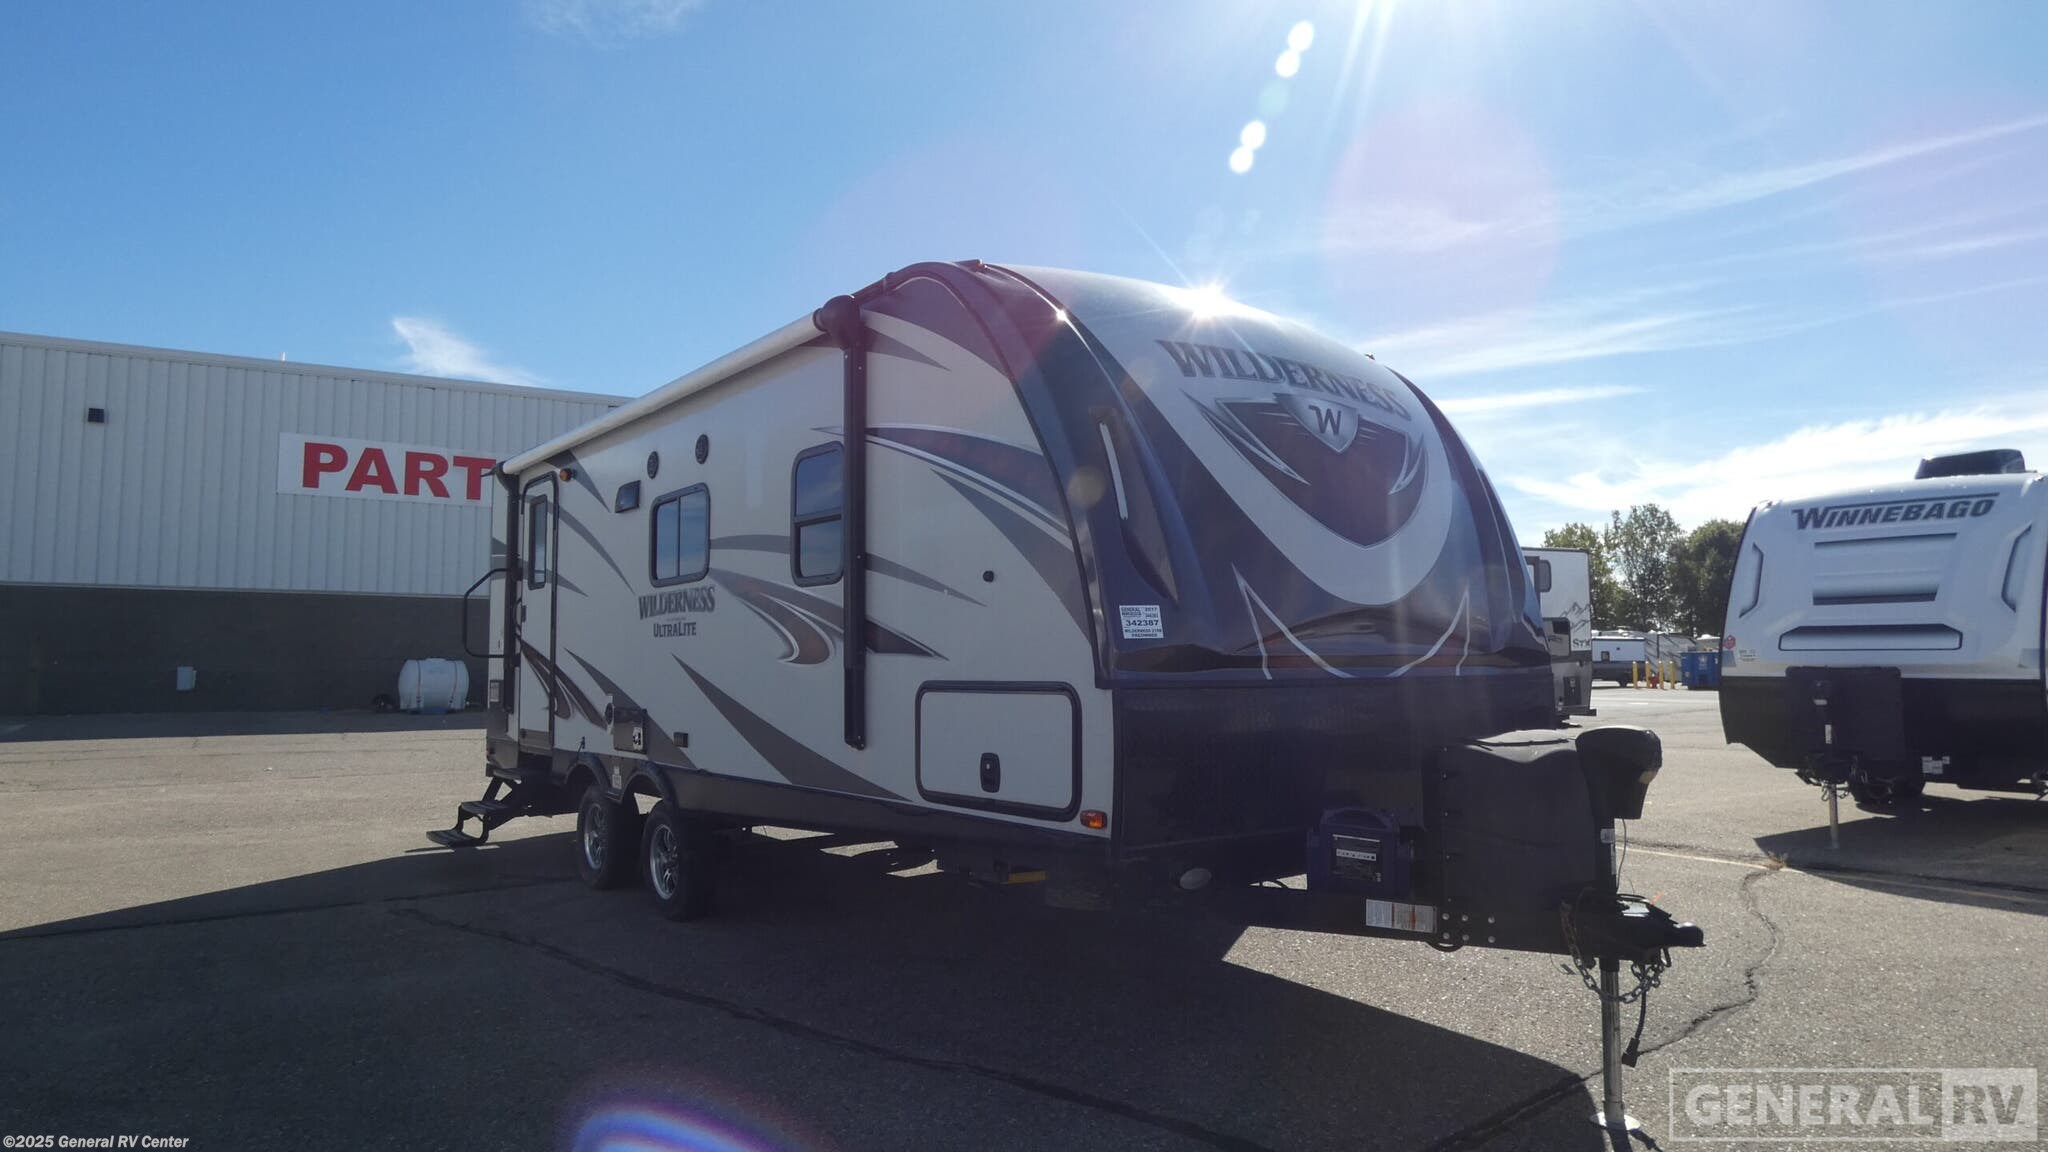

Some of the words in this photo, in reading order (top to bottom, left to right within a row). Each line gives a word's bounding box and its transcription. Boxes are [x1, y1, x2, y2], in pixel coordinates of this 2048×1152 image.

[1154, 339, 1412, 422] WILDERNESS
[1308, 403, 1342, 436] W
[1791, 498, 1996, 530] WINNEBAGO
[639, 586, 715, 620] WILDERNESS
